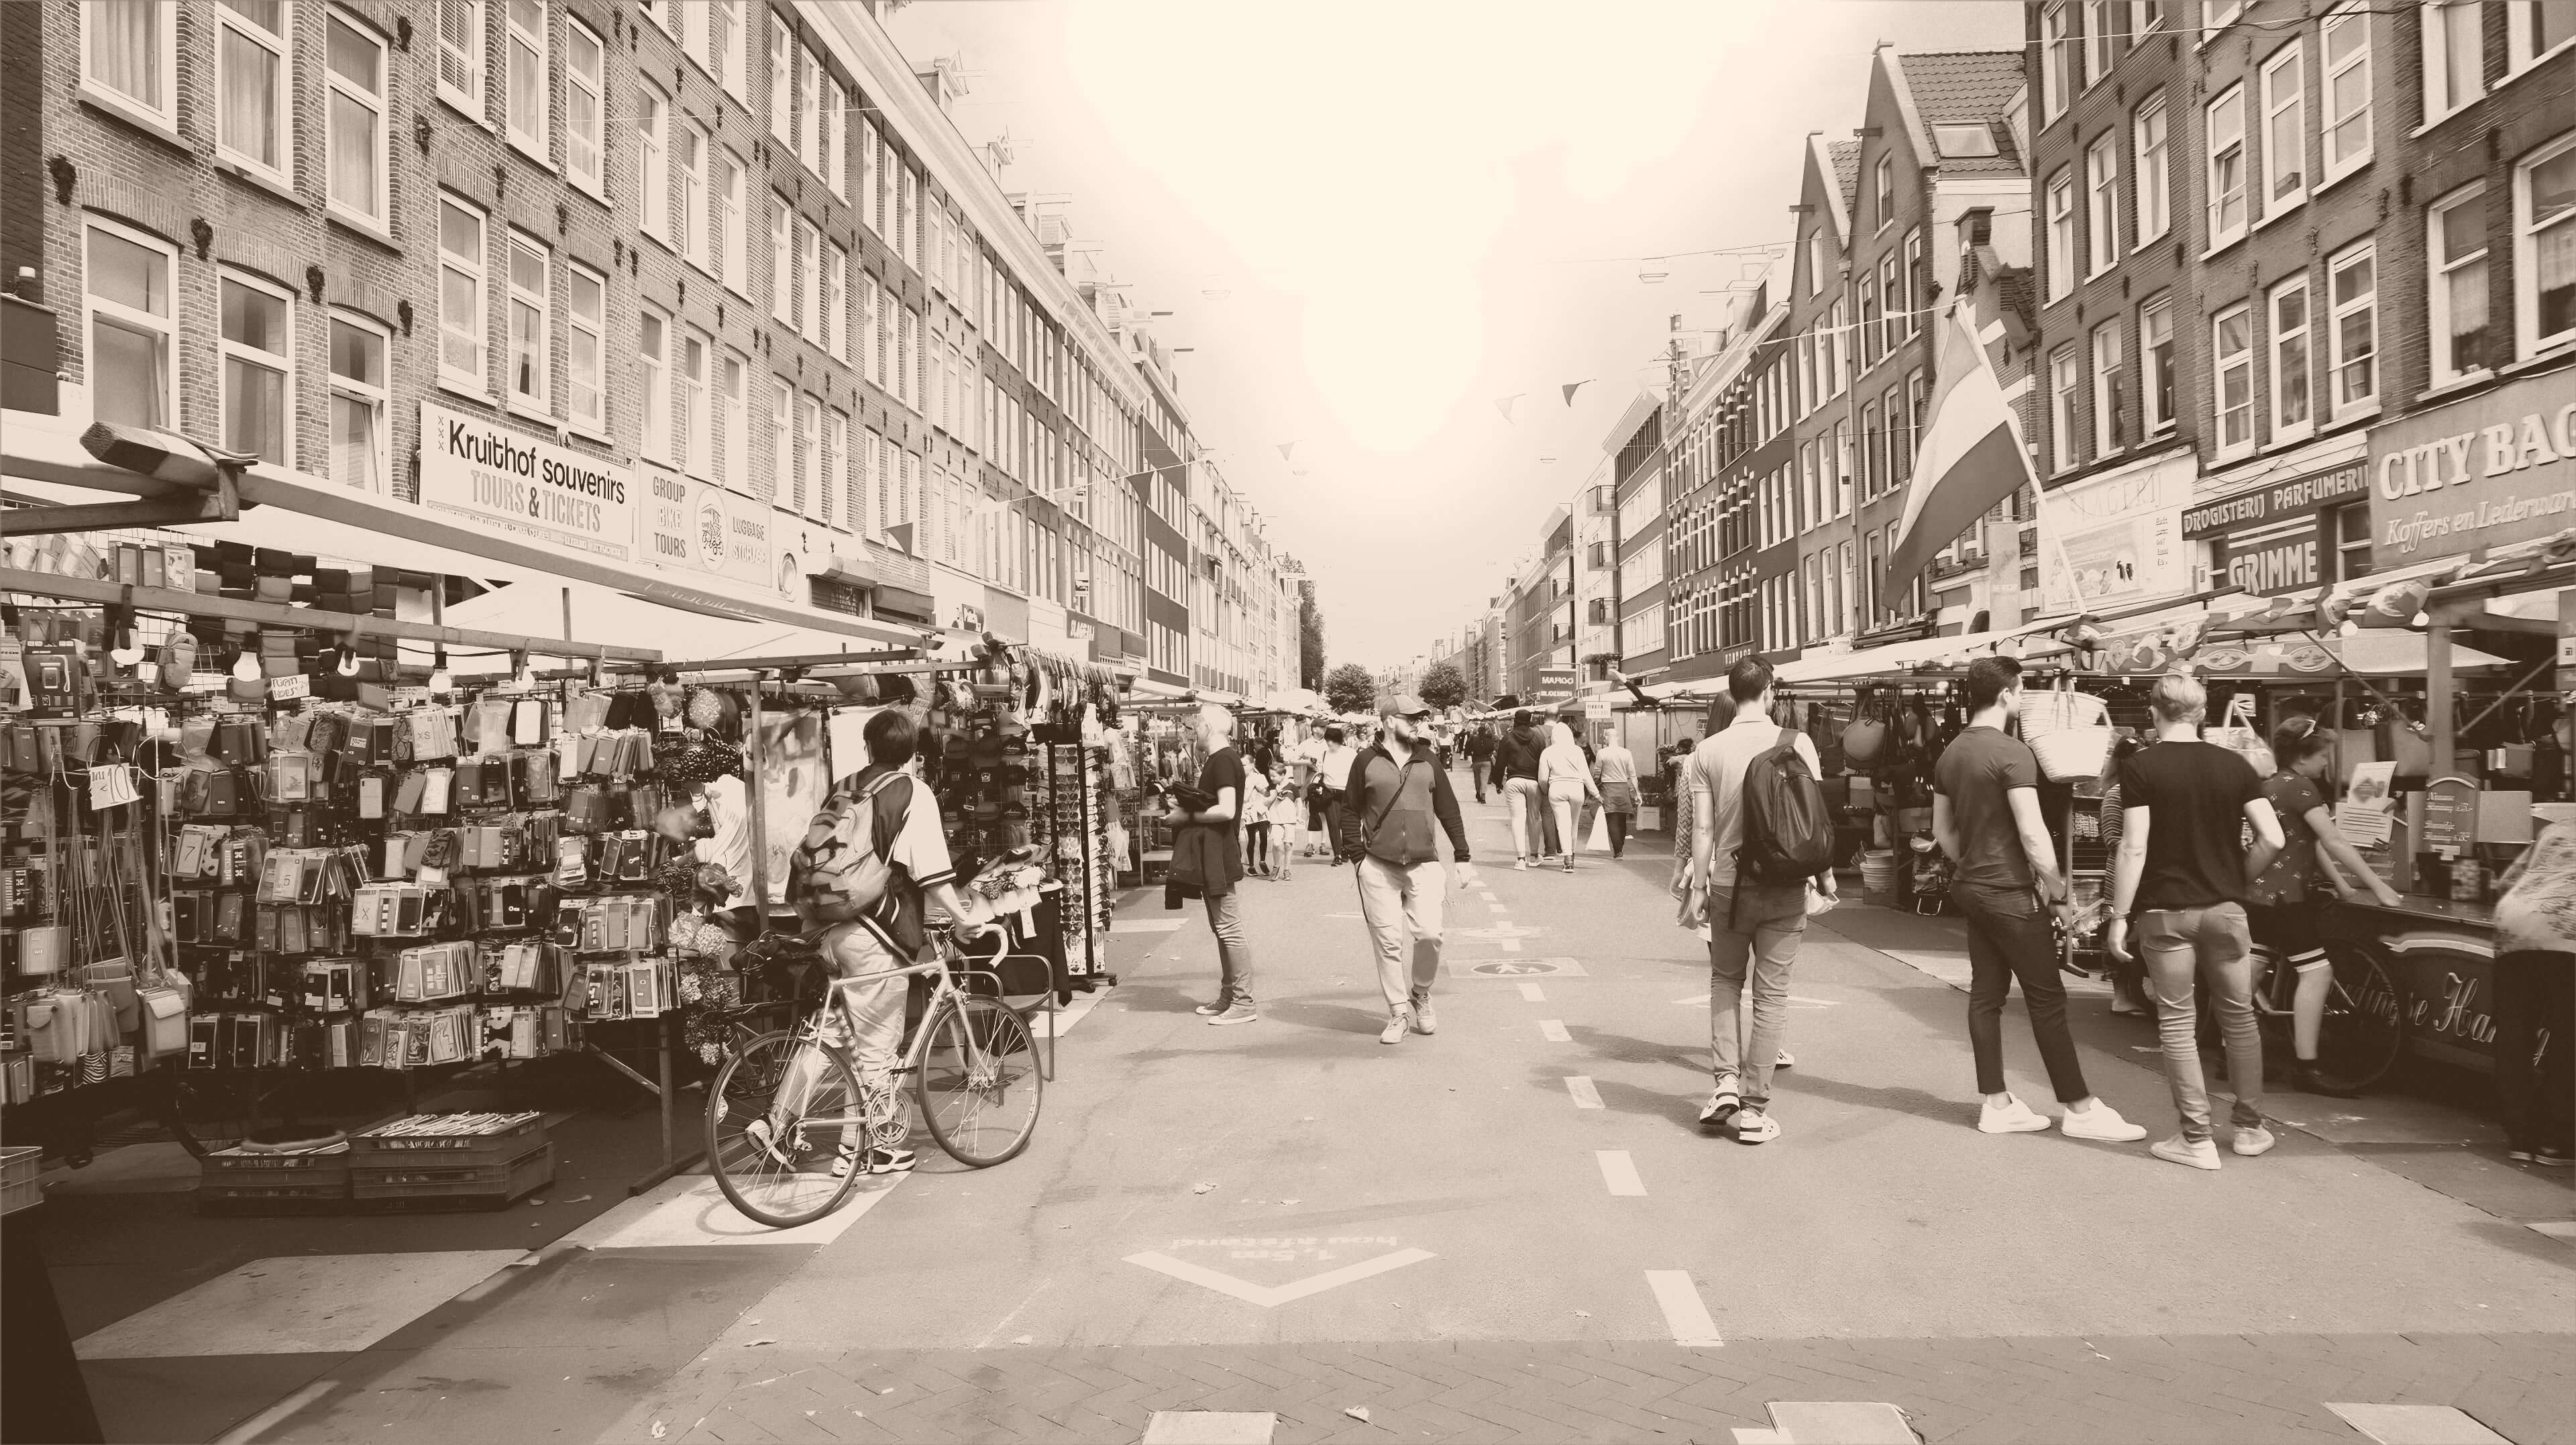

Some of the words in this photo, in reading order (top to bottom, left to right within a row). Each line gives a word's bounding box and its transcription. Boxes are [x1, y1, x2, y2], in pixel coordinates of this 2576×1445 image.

[449, 419, 536, 478] Kruithof
[542, 458, 625, 504] souvenirs
[2380, 431, 2477, 500] CITY
[470, 470, 525, 514] TOURS
[529, 486, 539, 519] &
[542, 489, 600, 533] TICKETS
[653, 476, 686, 504] GROUP
[2184, 493, 2265, 533] DROGISTERIJ
[654, 532, 686, 558] TOURS
[2383, 511, 2449, 553] Koffers
[2451, 511, 2475, 532] en
[2229, 541, 2318, 596] GRIMME
